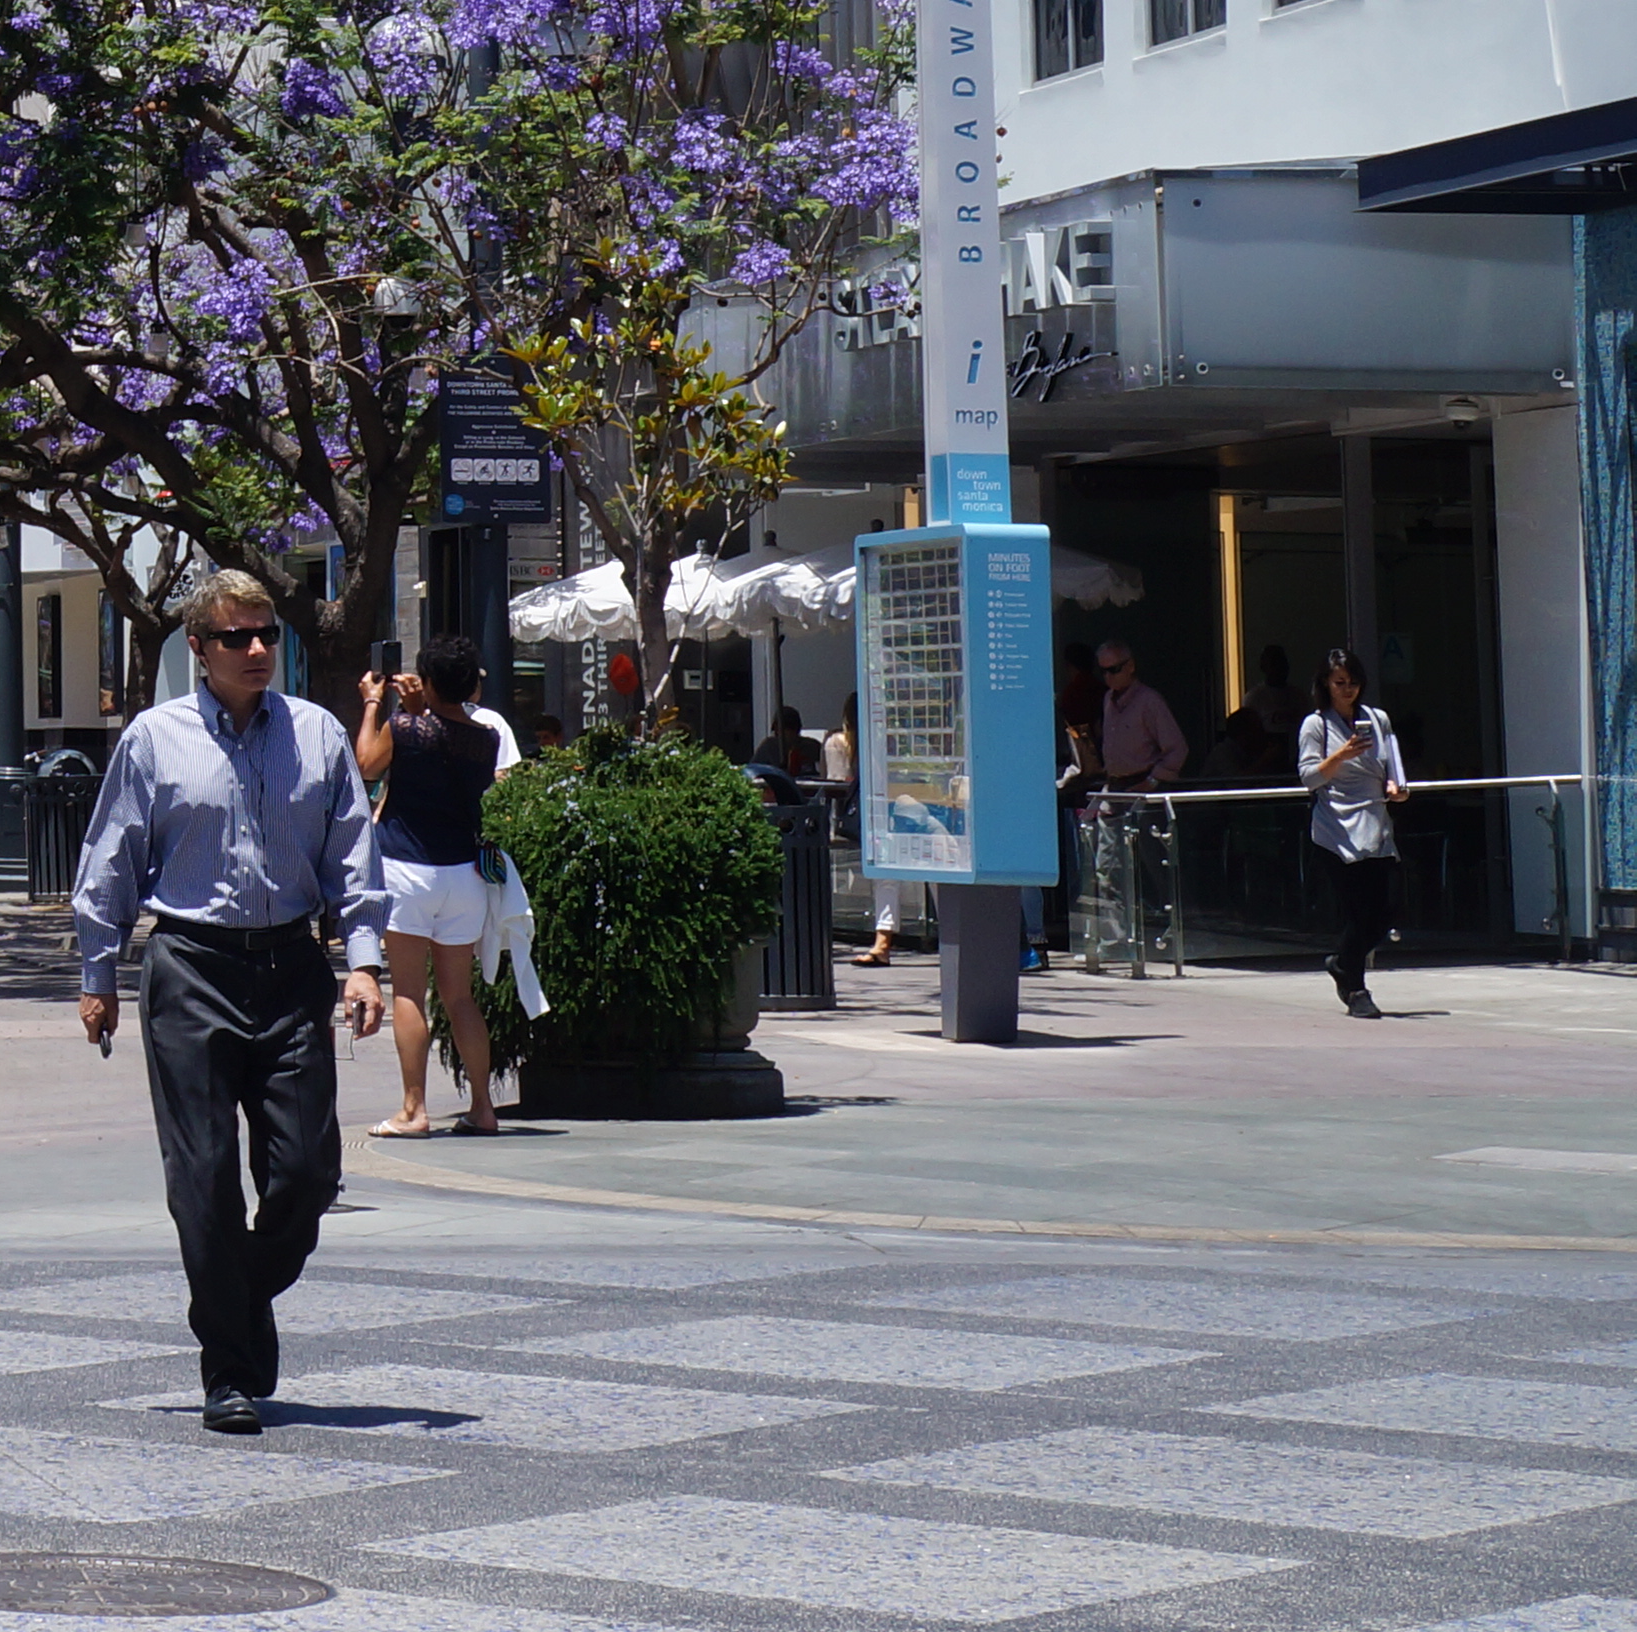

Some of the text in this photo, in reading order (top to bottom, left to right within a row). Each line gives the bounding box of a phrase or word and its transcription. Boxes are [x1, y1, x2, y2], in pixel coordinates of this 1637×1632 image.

[955, 409, 999, 431] map
[956, 469, 988, 480] down
[973, 481, 1002, 491] town
[958, 490, 989, 501] santa
[962, 501, 1004, 512] monica
[987, 553, 1031, 563] MINUTES
[988, 563, 1031, 573] ON FOOT
